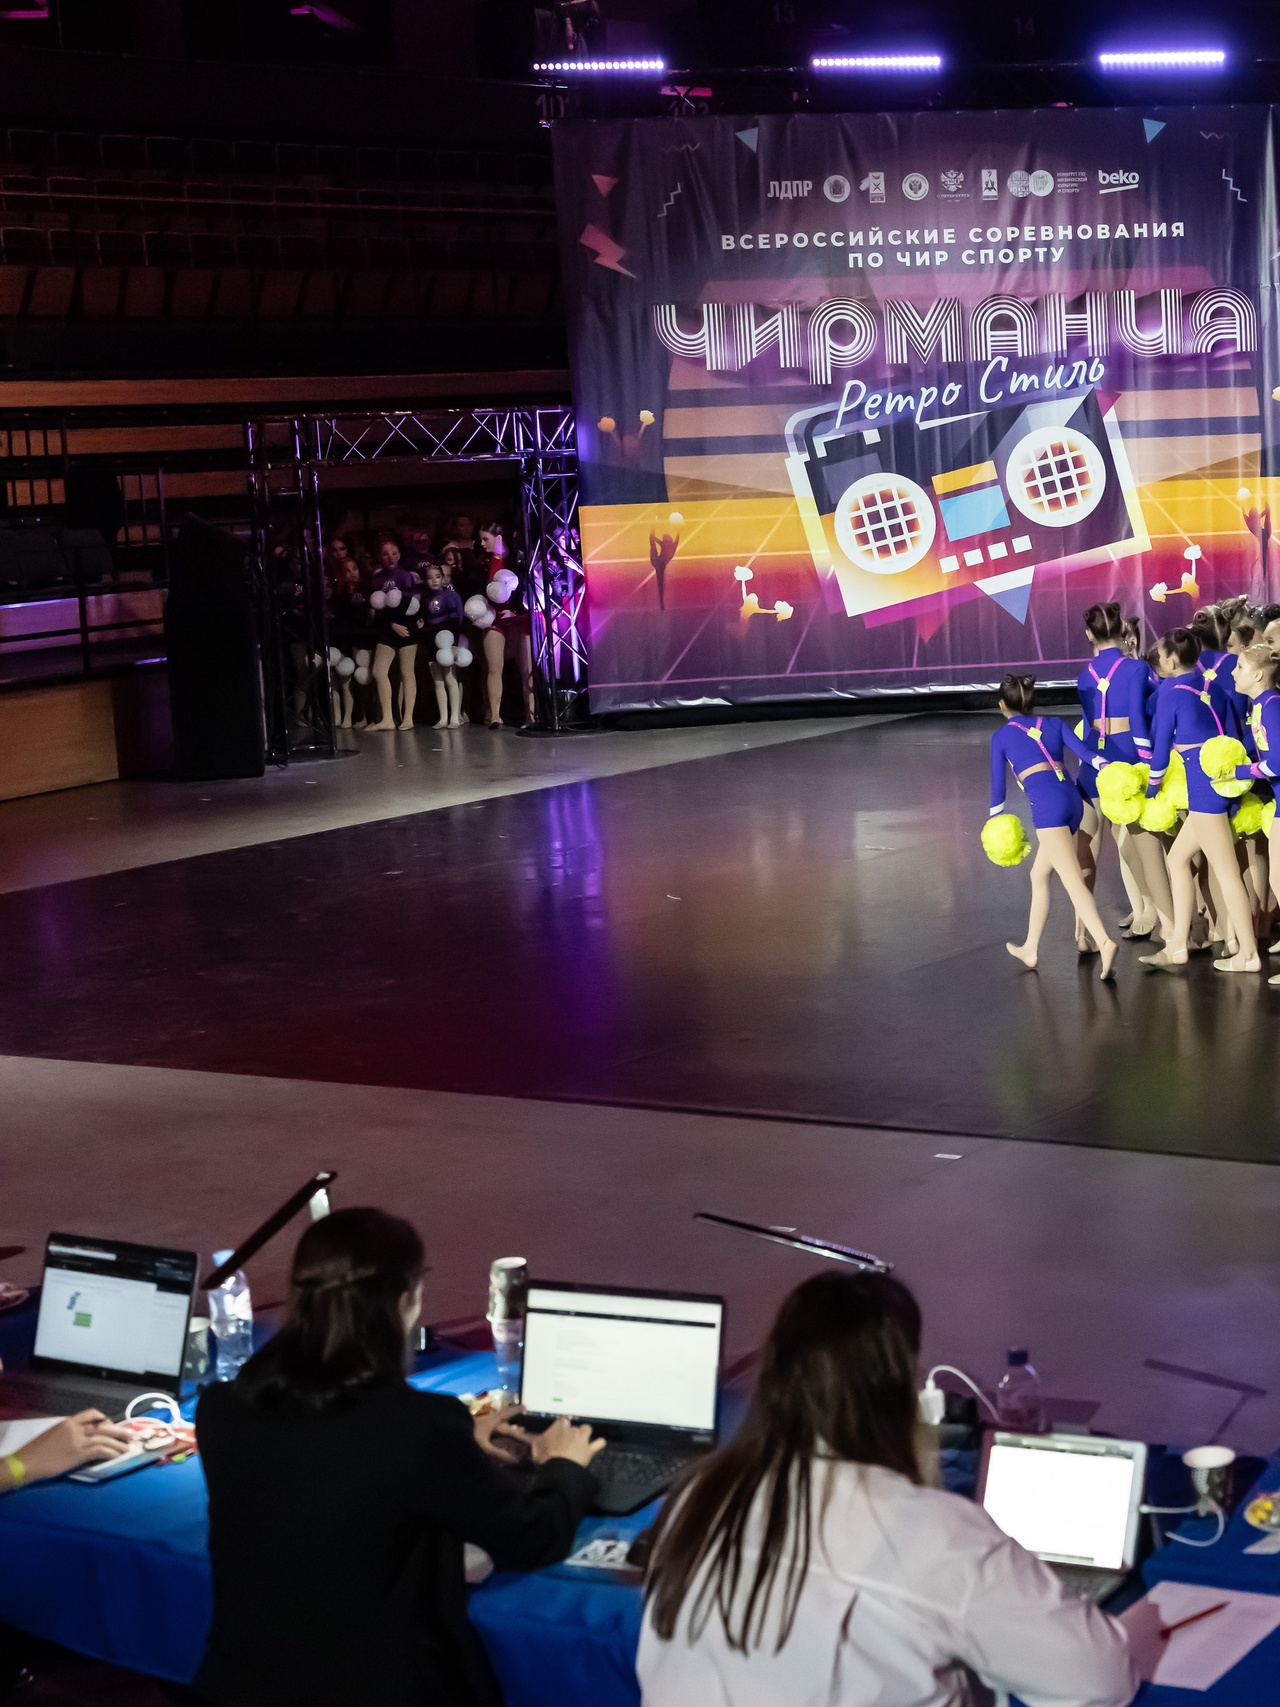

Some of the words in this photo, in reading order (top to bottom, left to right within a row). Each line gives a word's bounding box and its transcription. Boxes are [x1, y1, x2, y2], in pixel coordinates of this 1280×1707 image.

[1098, 169, 1140, 185] beko
[767, 180, 813, 200] ЛДПР
[721, 225, 956, 250] ВСЕРОССИЙСКИЕ
[968, 221, 1186, 244] СОРЕВНОВАНИЯ
[848, 251, 884, 268] ПО
[895, 248, 951, 267] ЧИР
[961, 246, 1065, 266] СПОРТУ
[835, 379, 962, 427] Ретро
[980, 355, 1105, 403] Стиль
